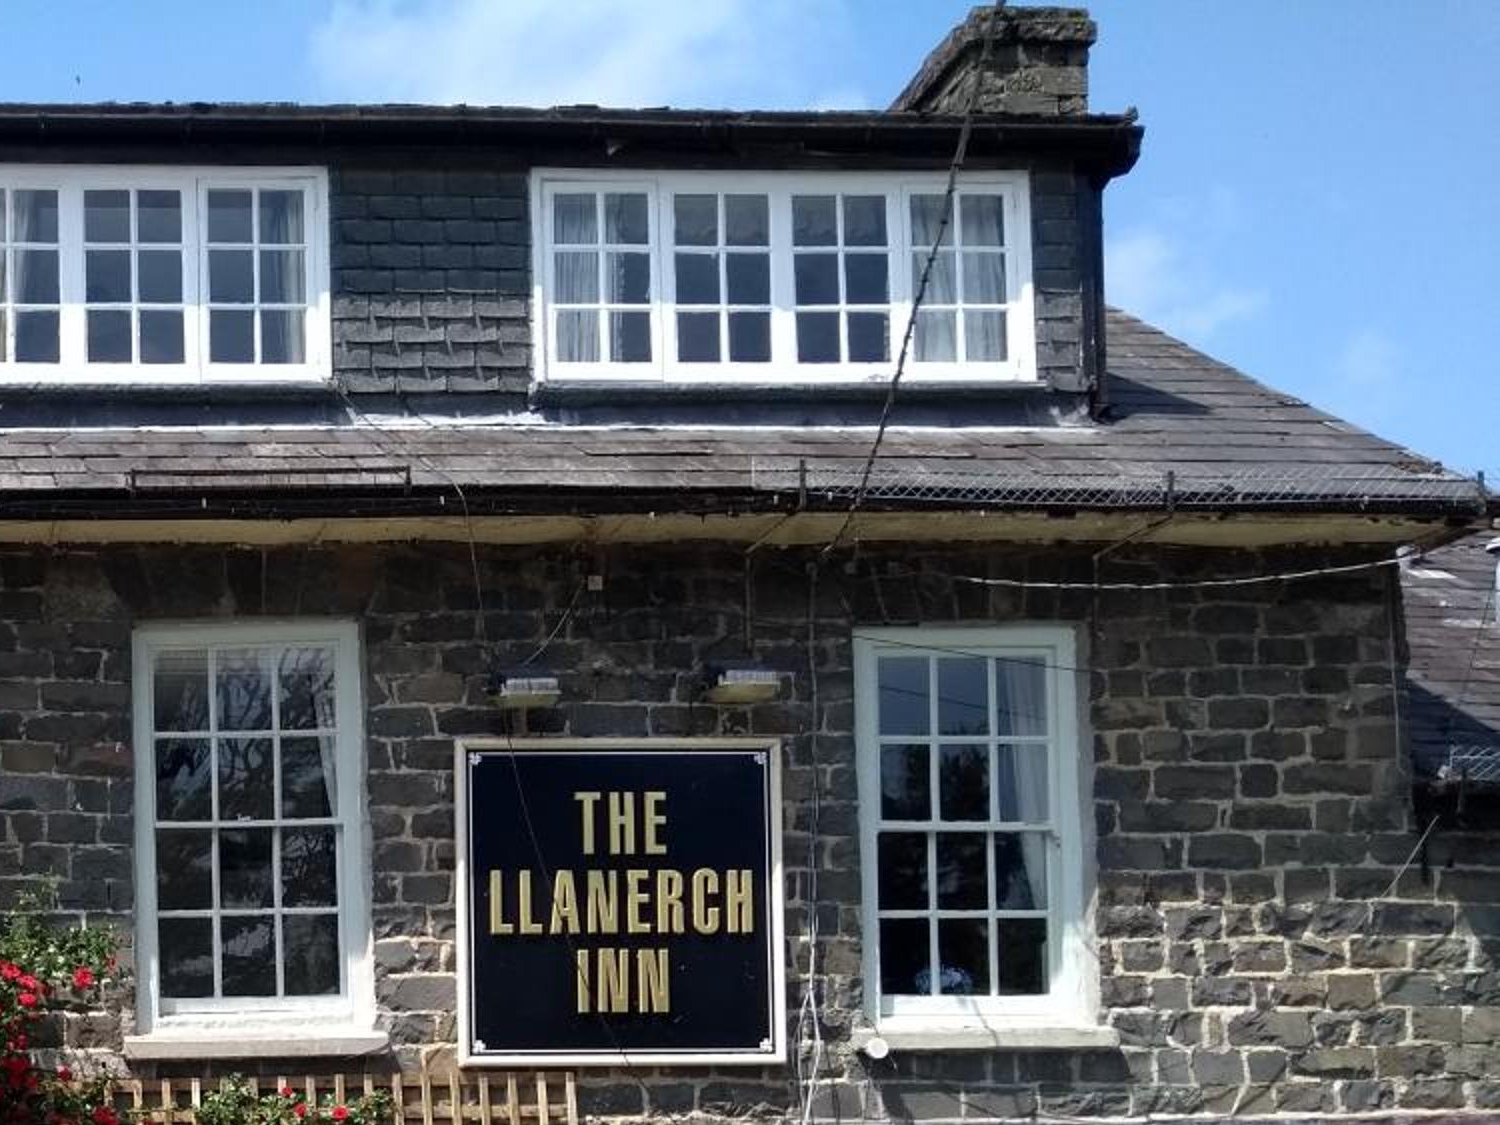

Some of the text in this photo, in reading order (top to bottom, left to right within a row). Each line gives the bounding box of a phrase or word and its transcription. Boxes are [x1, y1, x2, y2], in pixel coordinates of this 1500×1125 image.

[575, 791, 667, 855] THE
[489, 868, 754, 935] LLANERCH
[576, 947, 671, 1014] INN
